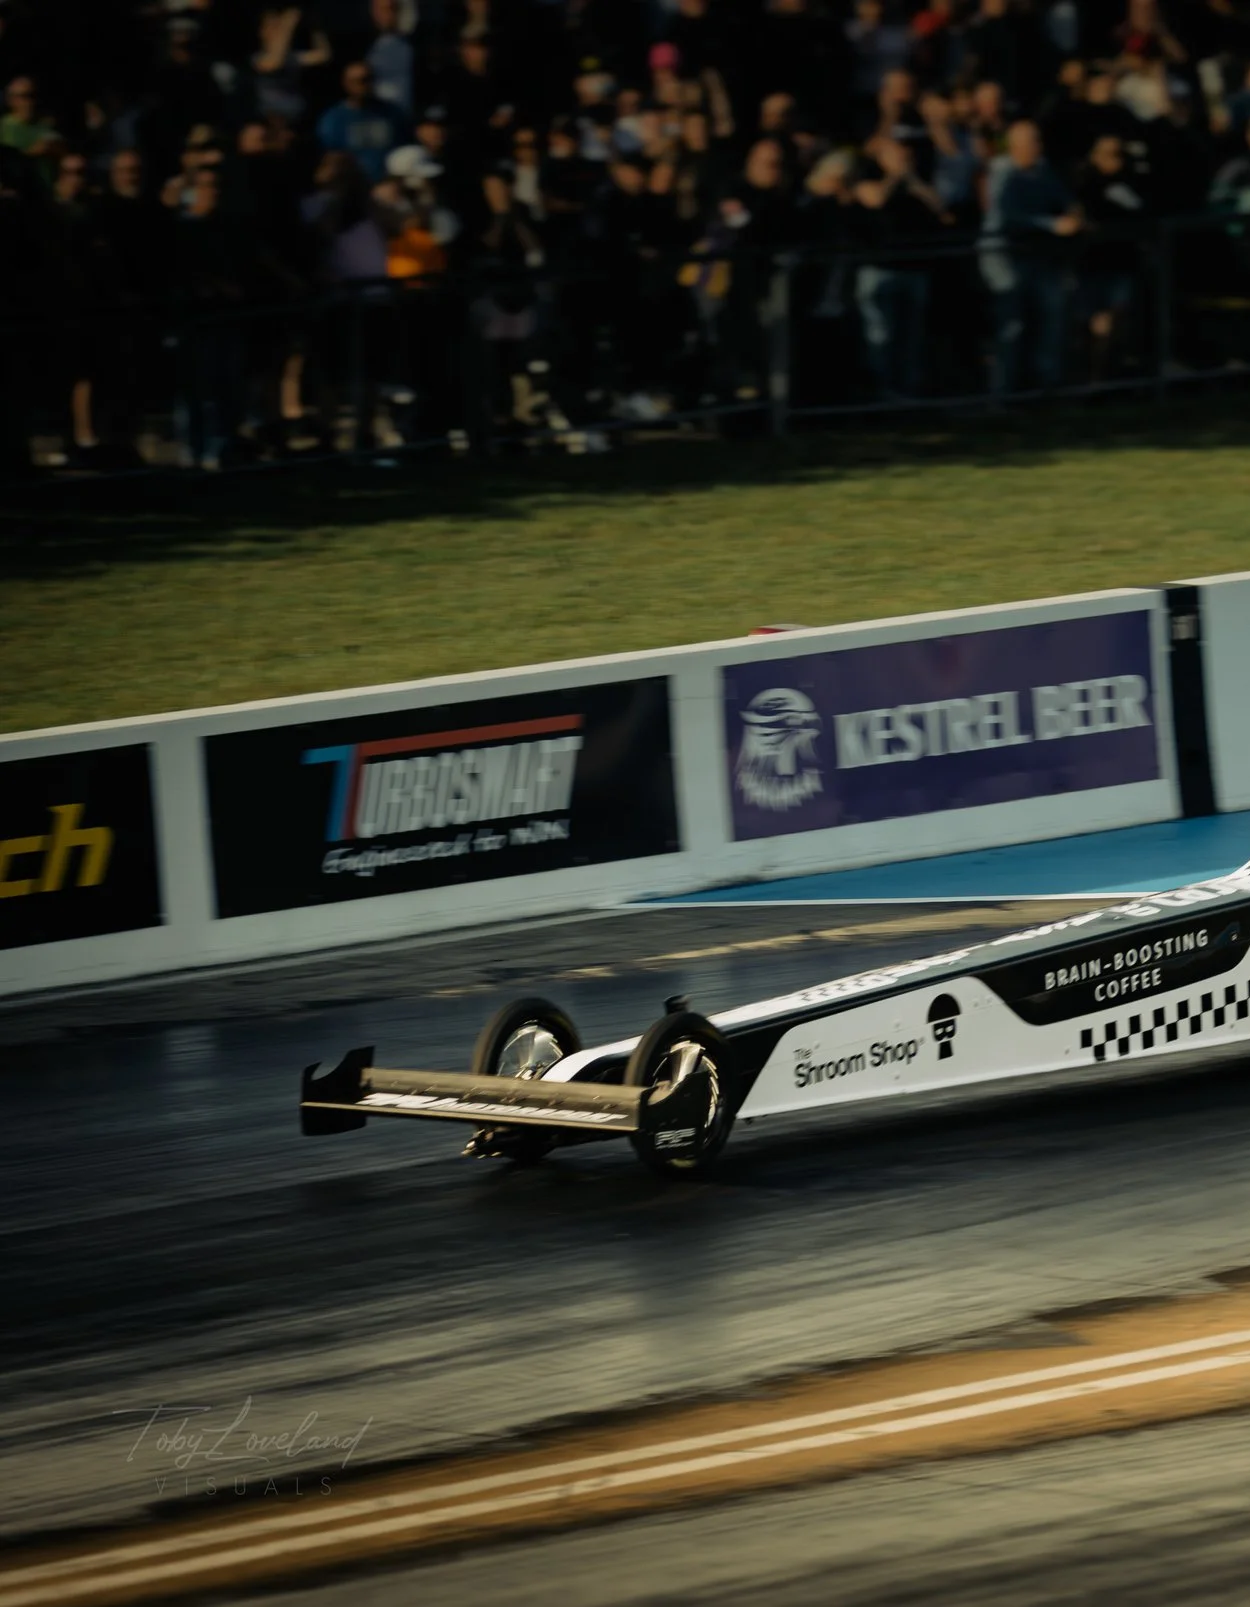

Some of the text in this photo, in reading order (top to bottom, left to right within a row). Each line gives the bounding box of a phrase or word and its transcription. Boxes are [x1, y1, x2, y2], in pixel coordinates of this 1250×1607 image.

[833, 674, 1153, 769] KESTREL BEER
[1044, 928, 1209, 991] BRAIN-BOOSTING
[1094, 967, 1163, 1002] COFFEE
[794, 1037, 920, 1089] Shroom Shop
